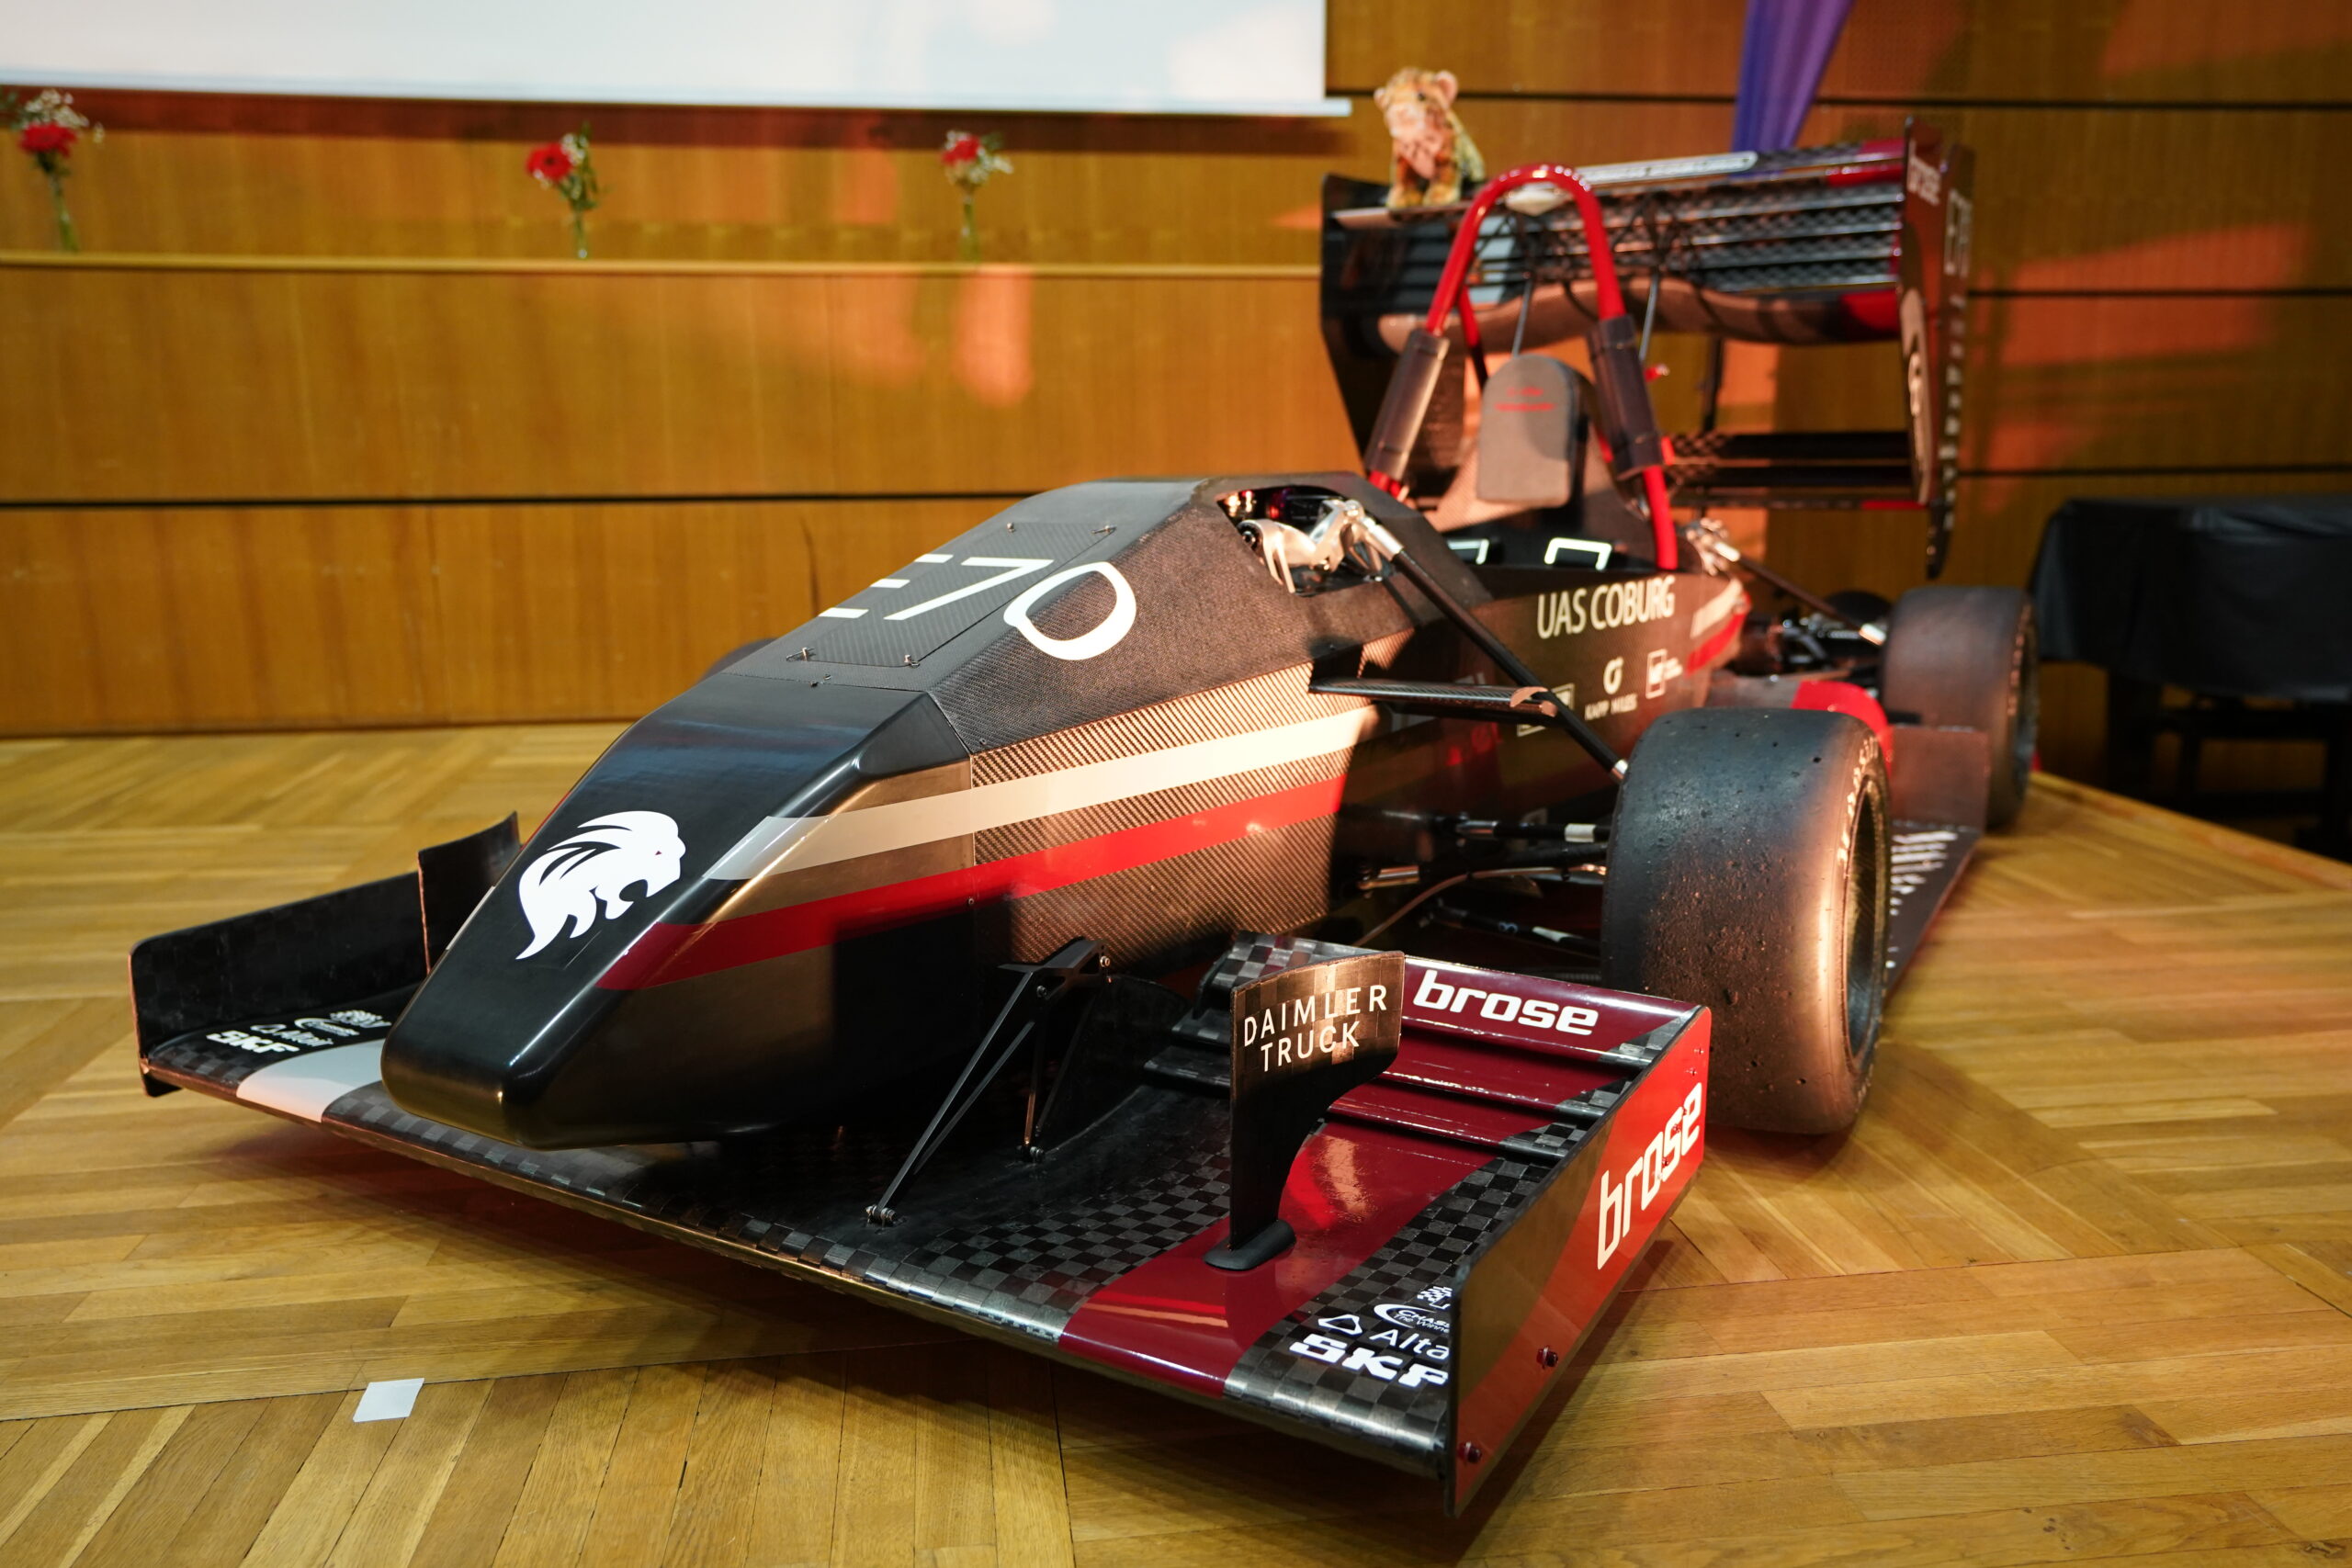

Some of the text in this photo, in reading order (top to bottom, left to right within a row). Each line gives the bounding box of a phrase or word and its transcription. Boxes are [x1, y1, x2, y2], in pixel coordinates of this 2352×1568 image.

[1537, 575, 1676, 639] UAS COBURG
[1244, 985, 1387, 1047] DAIMLER
[1412, 969, 1600, 1035] brose
[206, 1030, 300, 1054] SKF
[1261, 1021, 1360, 1073] TRUCK
[1597, 1081, 1702, 1270] brose
[1369, 1328, 1450, 1360] Alta
[1394, 1314, 1450, 1334] The Winne
[1289, 1333, 1449, 1388] SKF
